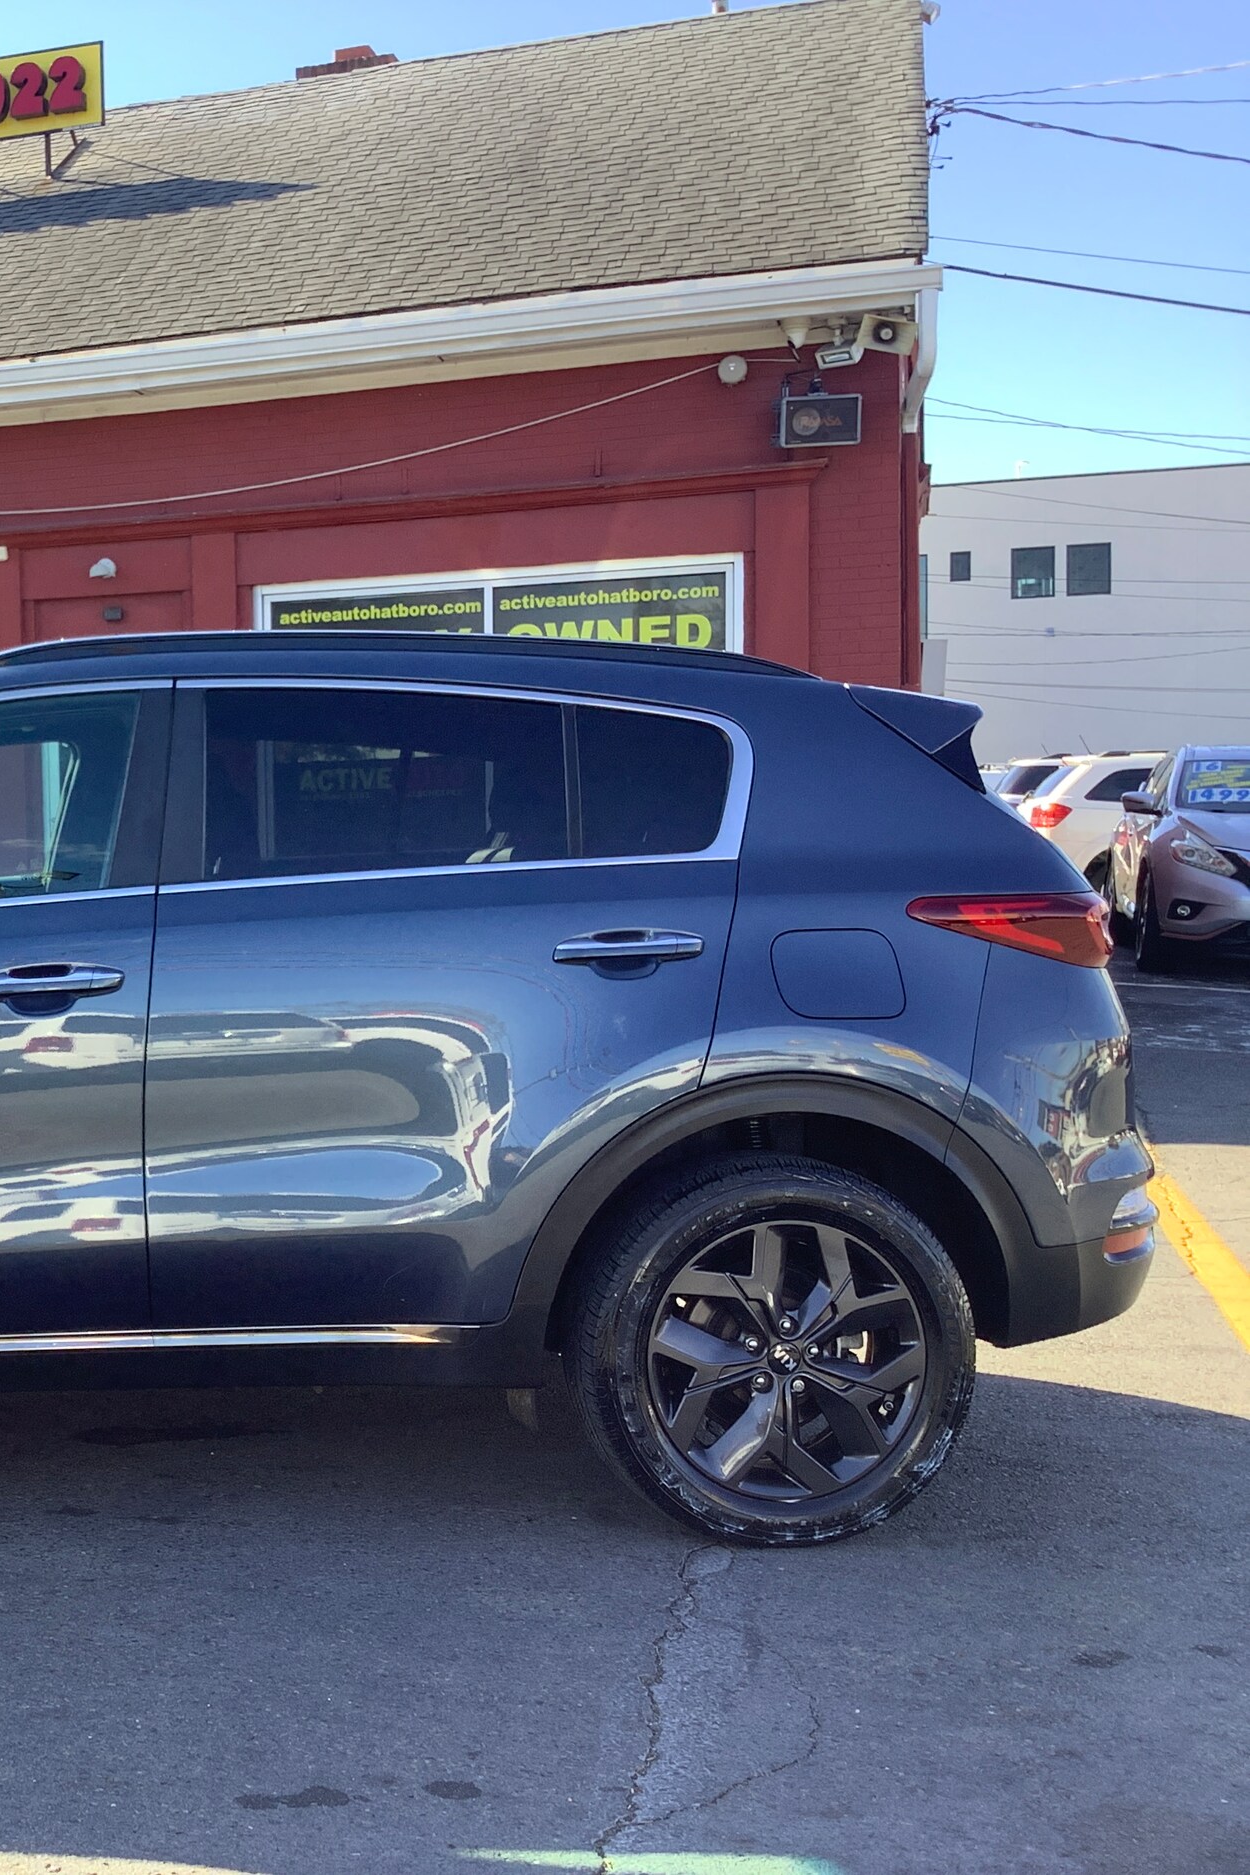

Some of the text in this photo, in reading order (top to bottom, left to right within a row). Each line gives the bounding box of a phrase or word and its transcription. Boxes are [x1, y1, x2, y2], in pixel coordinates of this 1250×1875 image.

[499, 585, 720, 611] activeautohatboro.com
[279, 601, 482, 625] activeautohatboro.com
[774, 1345, 798, 1371] KIA
